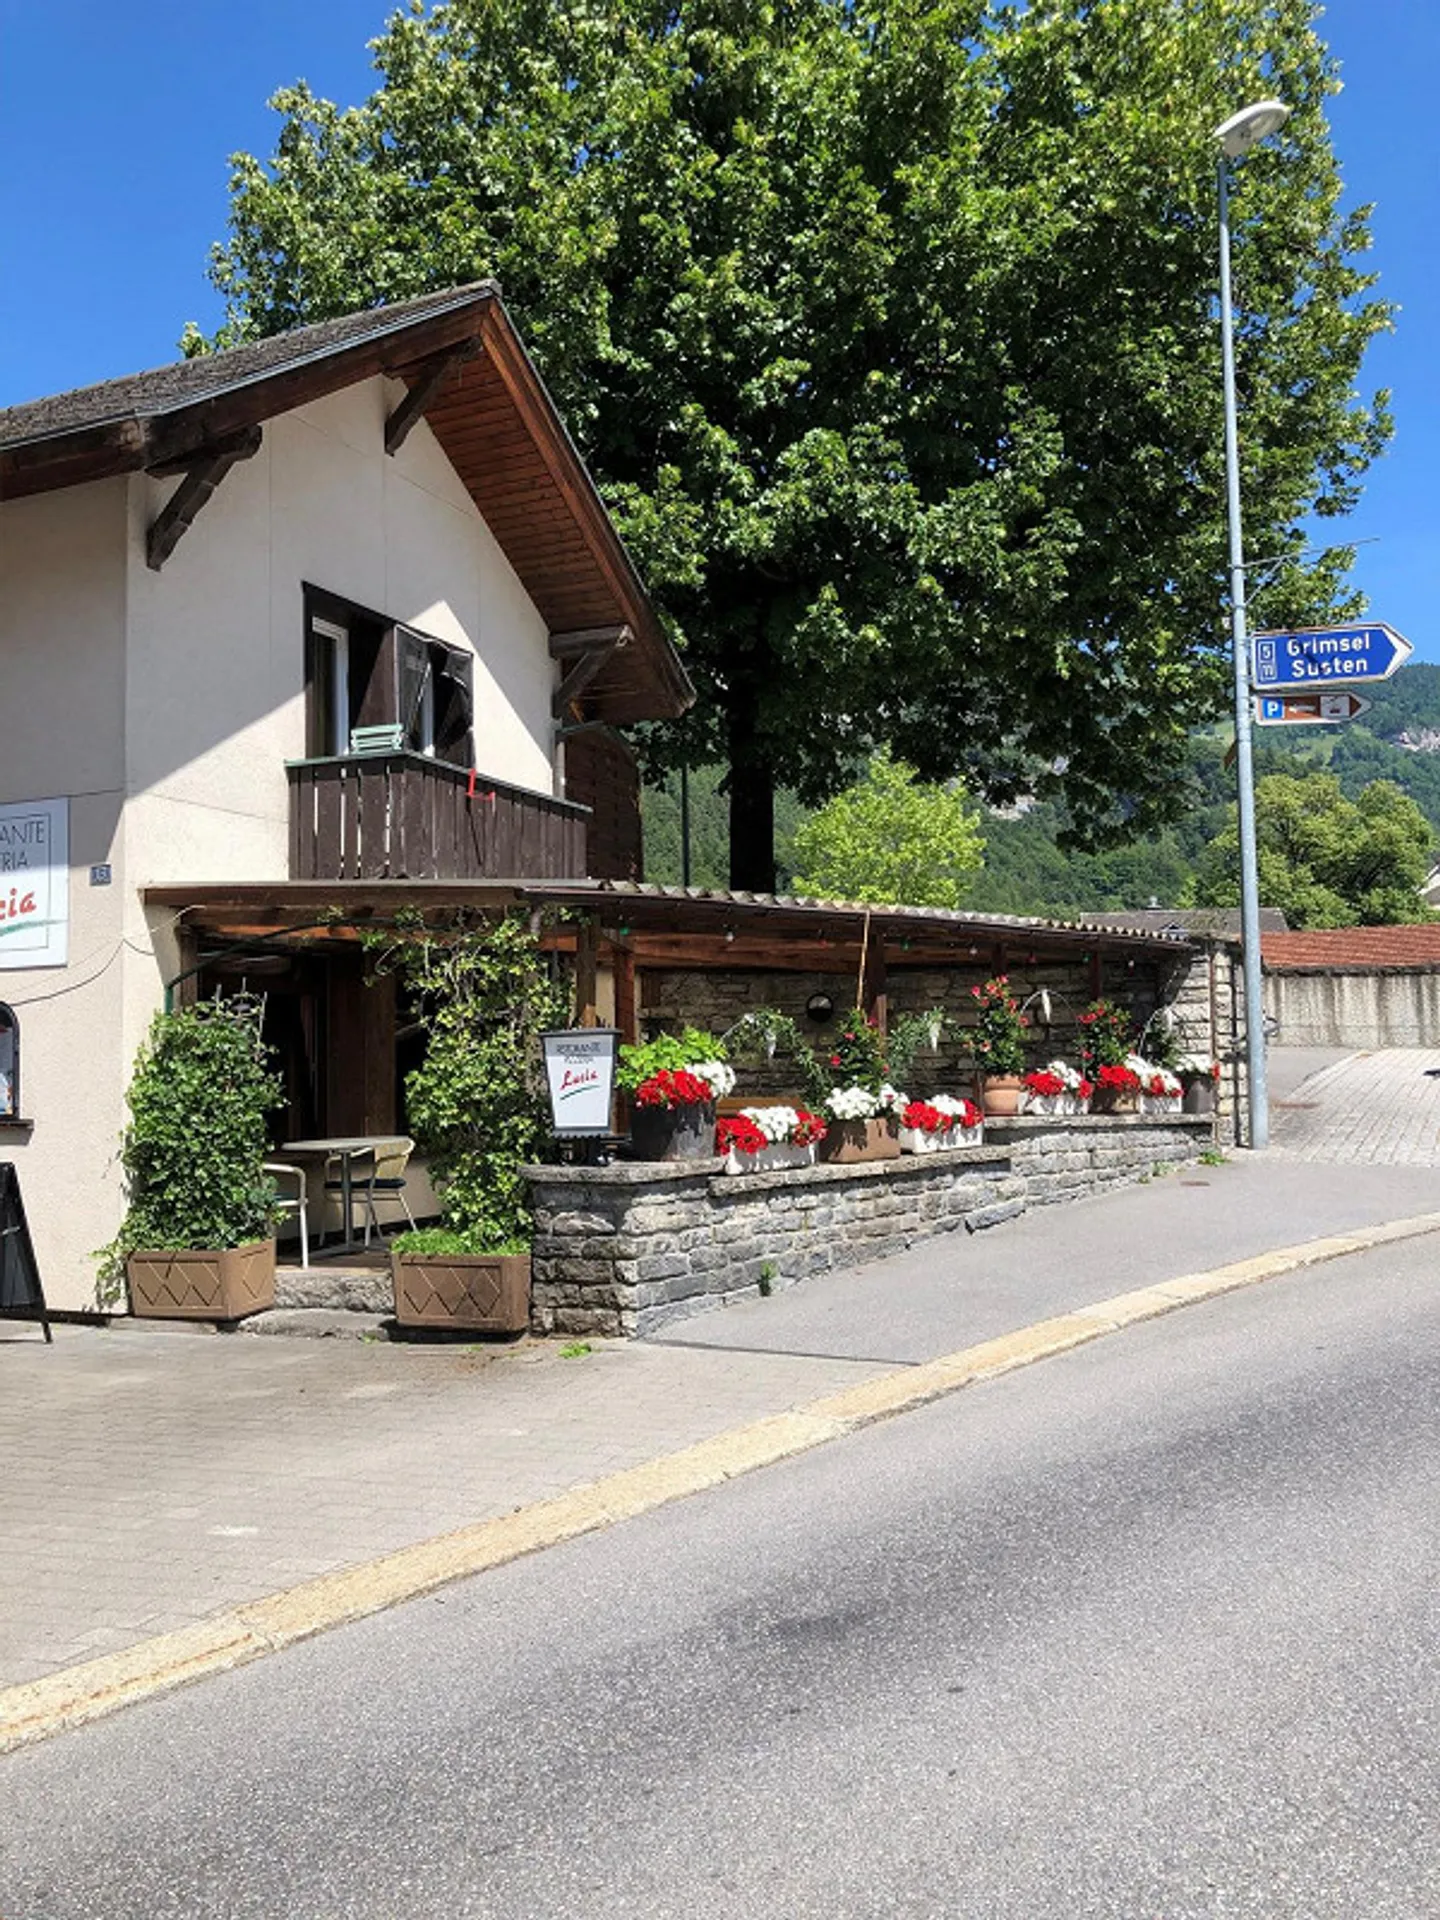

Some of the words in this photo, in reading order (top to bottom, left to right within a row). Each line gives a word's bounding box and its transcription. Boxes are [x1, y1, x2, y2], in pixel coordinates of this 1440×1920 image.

[1286, 632, 1371, 657] Grimsel
[1291, 657, 1369, 678] Susten
[1267, 700, 1279, 717] P
